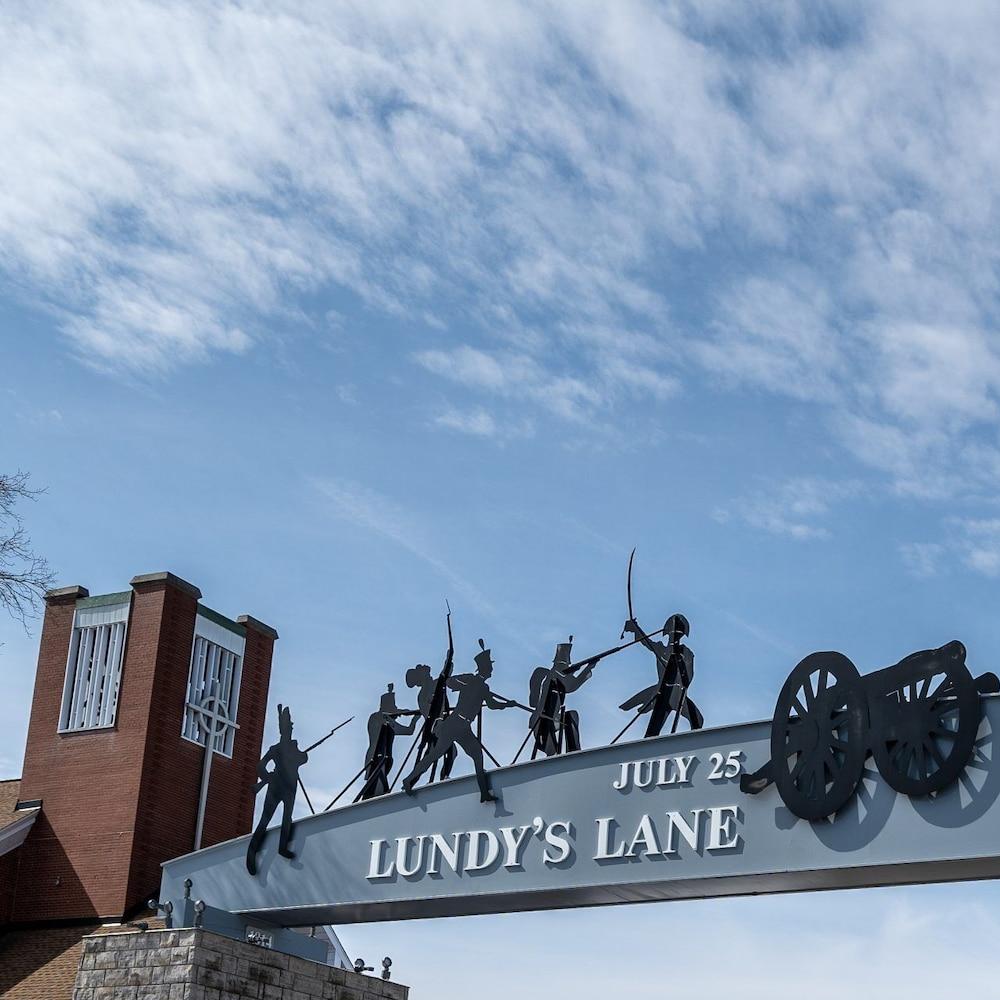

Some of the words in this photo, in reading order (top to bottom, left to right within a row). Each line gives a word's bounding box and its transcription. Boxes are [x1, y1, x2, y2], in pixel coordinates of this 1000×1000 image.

[613, 756, 696, 790] JULY
[708, 750, 743, 780] 25
[366, 816, 573, 880] LUNDY'S
[593, 804, 741, 861] LANE
